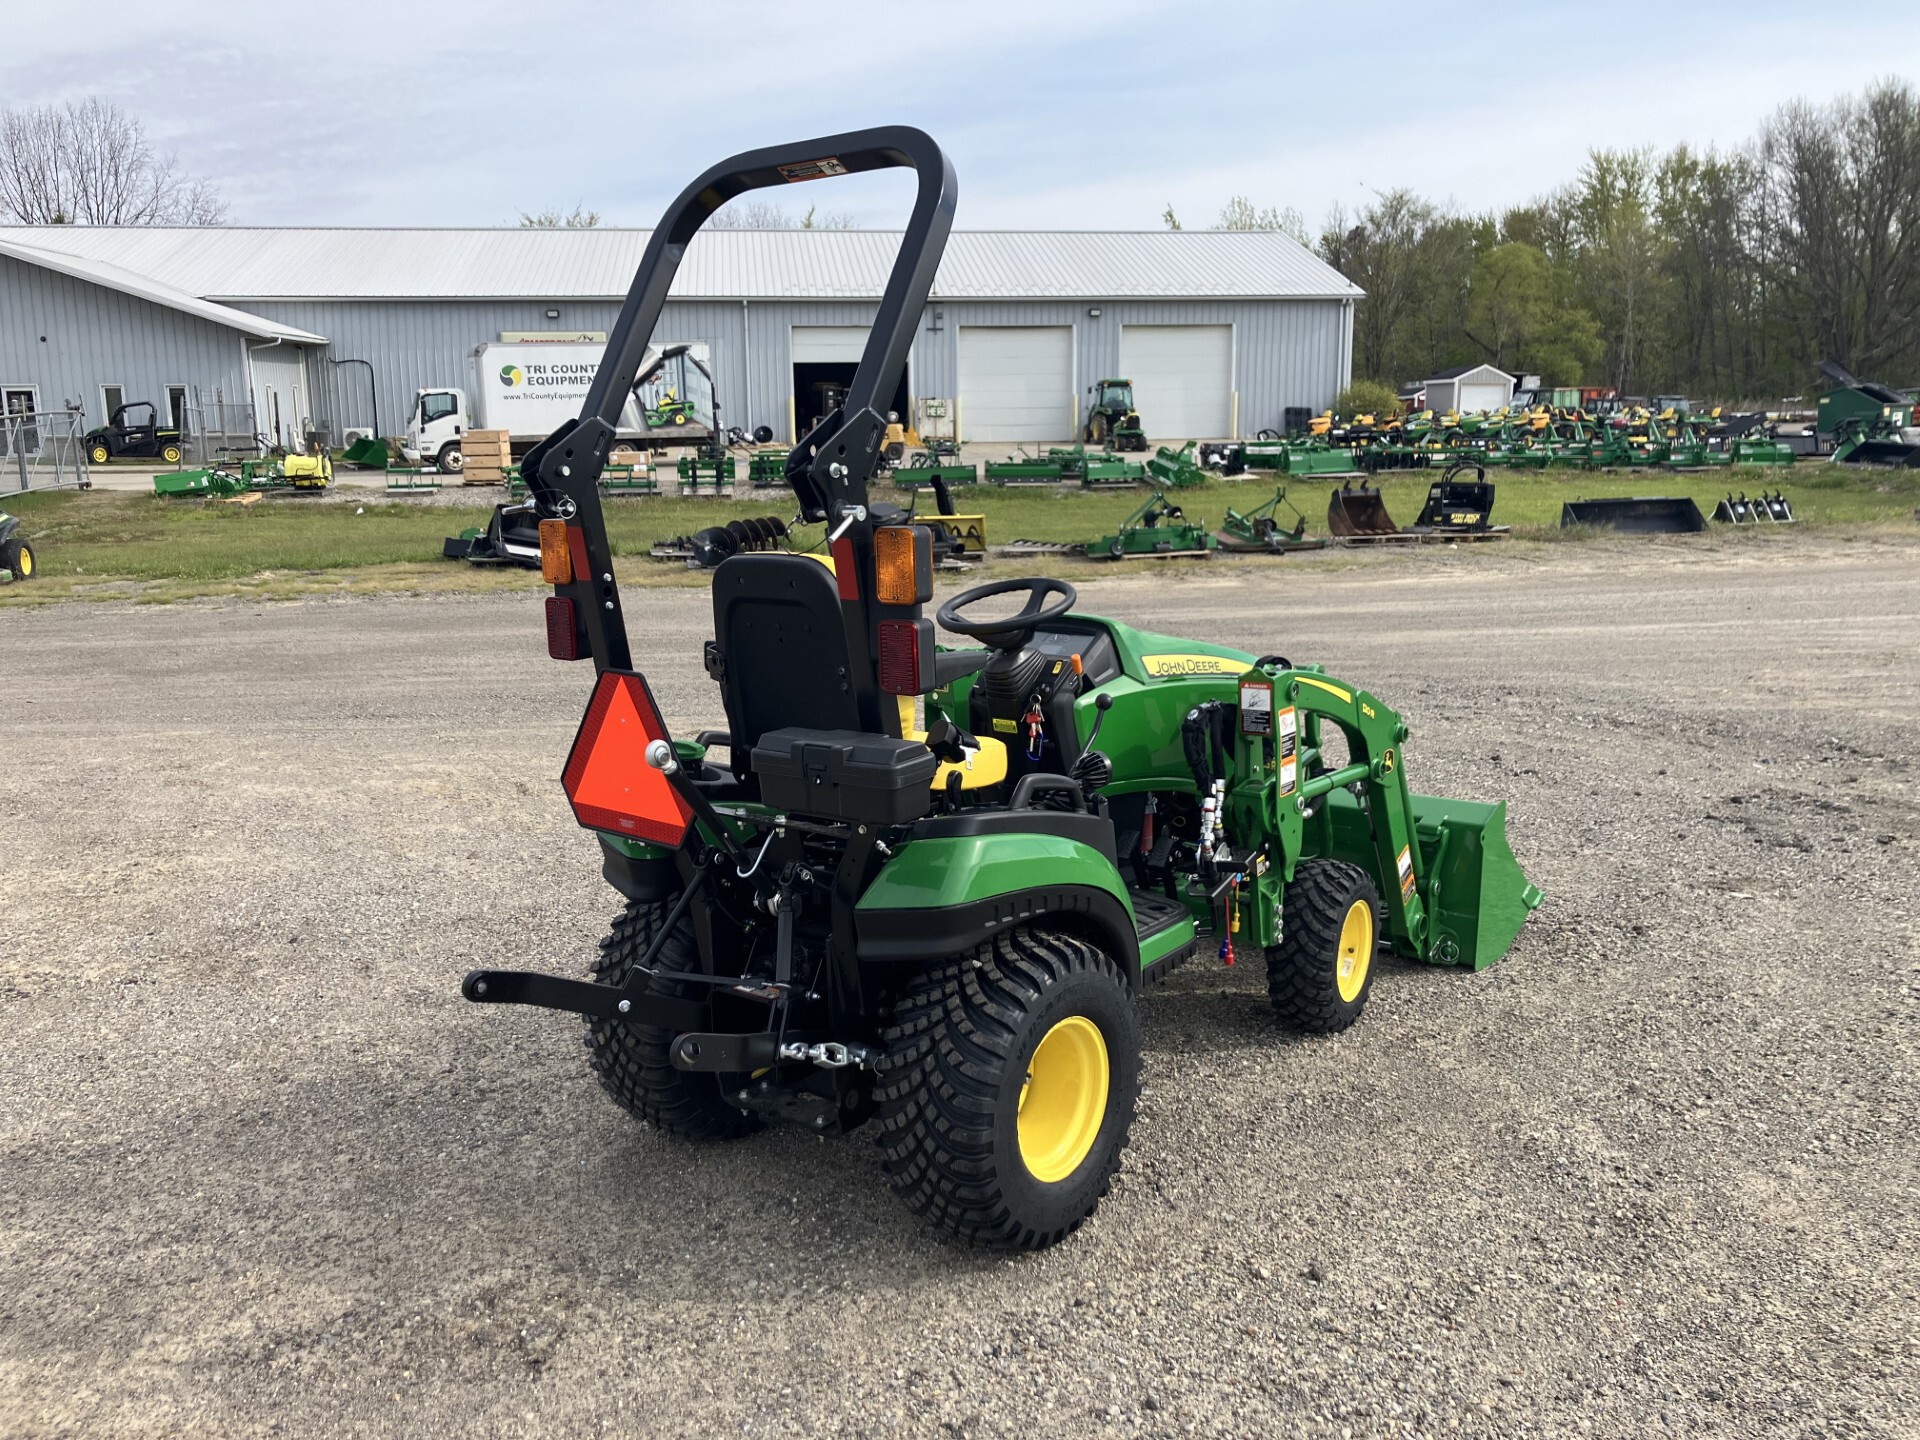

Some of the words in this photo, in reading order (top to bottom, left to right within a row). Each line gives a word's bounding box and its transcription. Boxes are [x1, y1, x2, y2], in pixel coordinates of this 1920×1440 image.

[524, 365, 546, 374] TRI
[551, 364, 600, 374] COUNT
[527, 376, 595, 386] EQUIPMEN
[503, 392, 588, 401] www.TriCountyEquipmen
[1155, 660, 1185, 674] JOHN
[1186, 659, 1221, 671] DEERE
